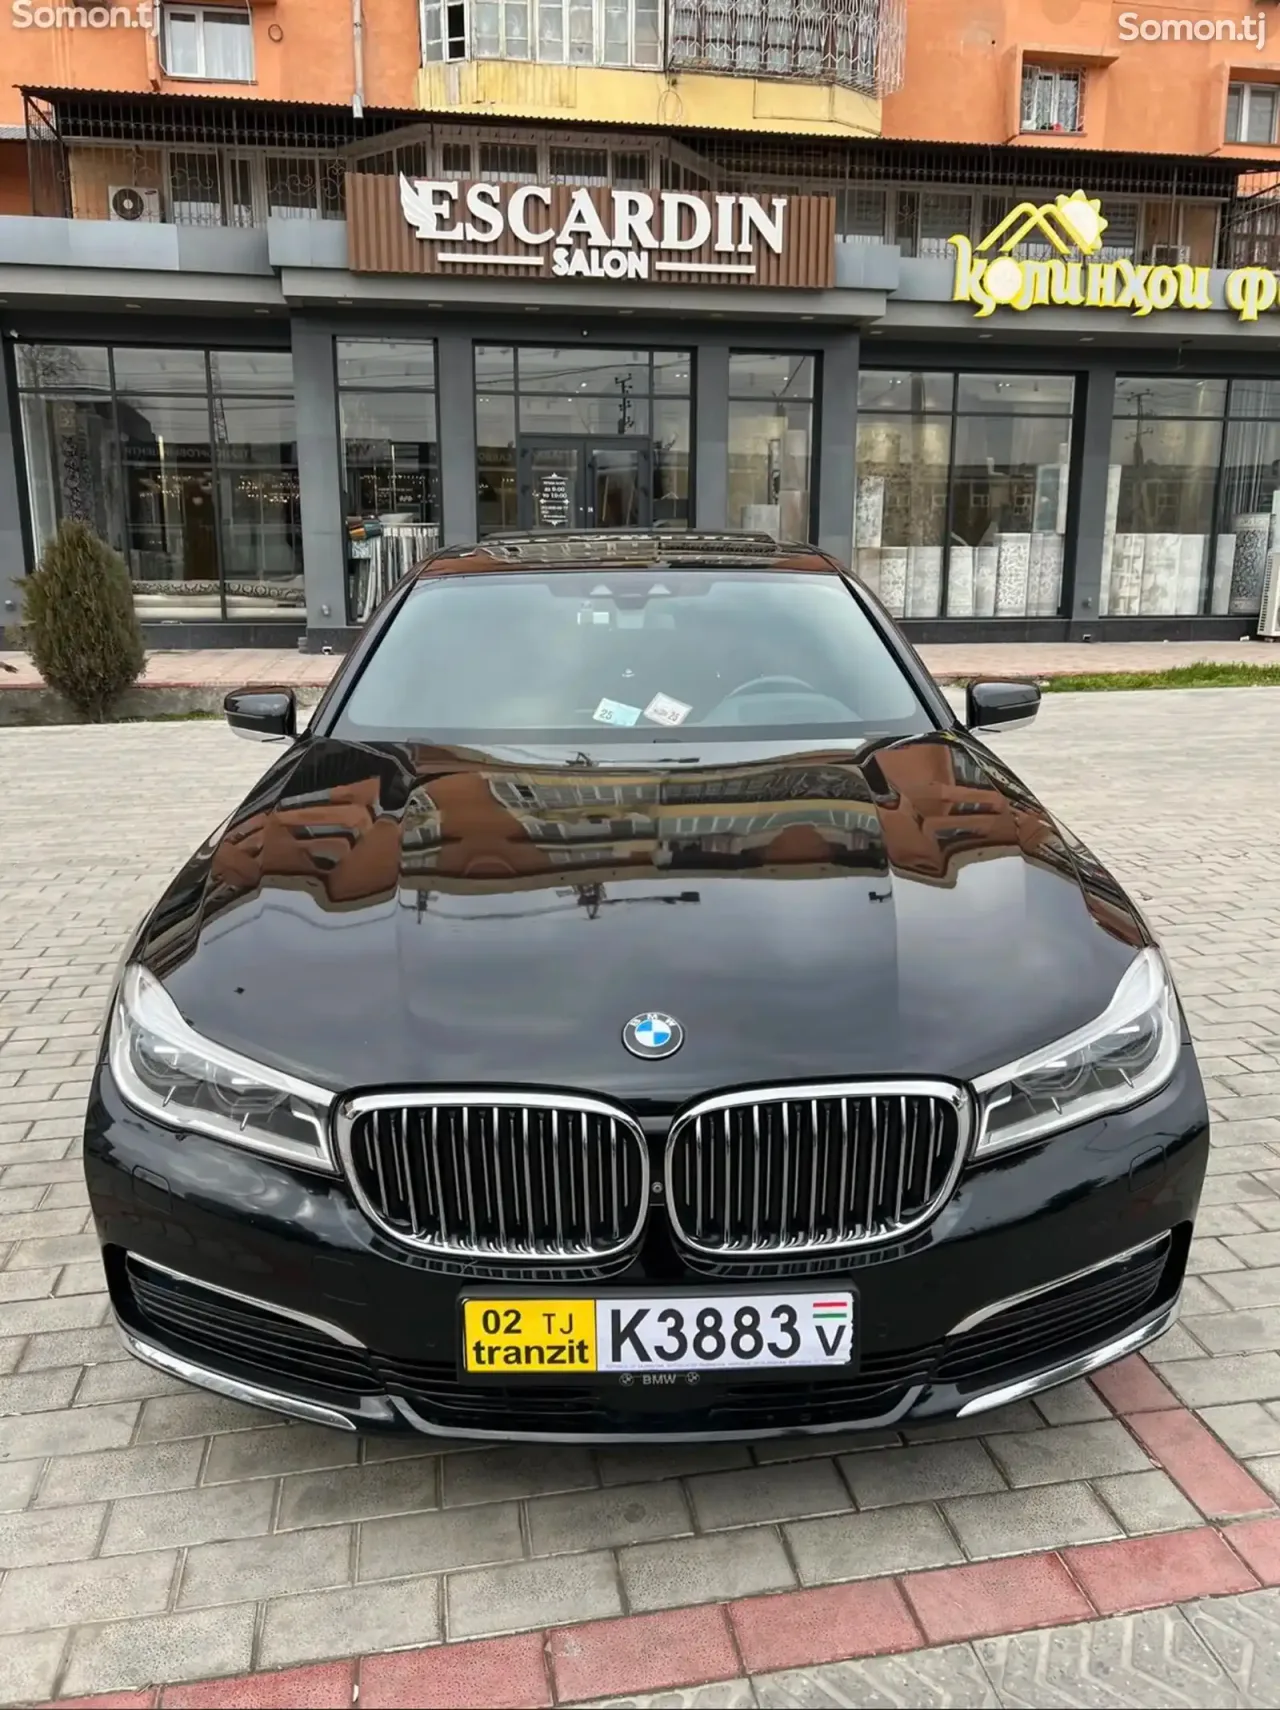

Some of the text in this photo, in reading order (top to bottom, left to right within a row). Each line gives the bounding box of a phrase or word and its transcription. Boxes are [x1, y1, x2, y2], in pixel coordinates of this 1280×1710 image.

[413, 179, 788, 254] ESCARDIN
[551, 246, 649, 279] SALON
[1225, 265, 1280, 322] ф
[628, 1012, 678, 1027] BMW
[482, 1308, 573, 1335] 02 TJ
[611, 1304, 847, 1364] K3883 V
[472, 1338, 590, 1365] tranzit
[642, 1373, 677, 1385] BMW
